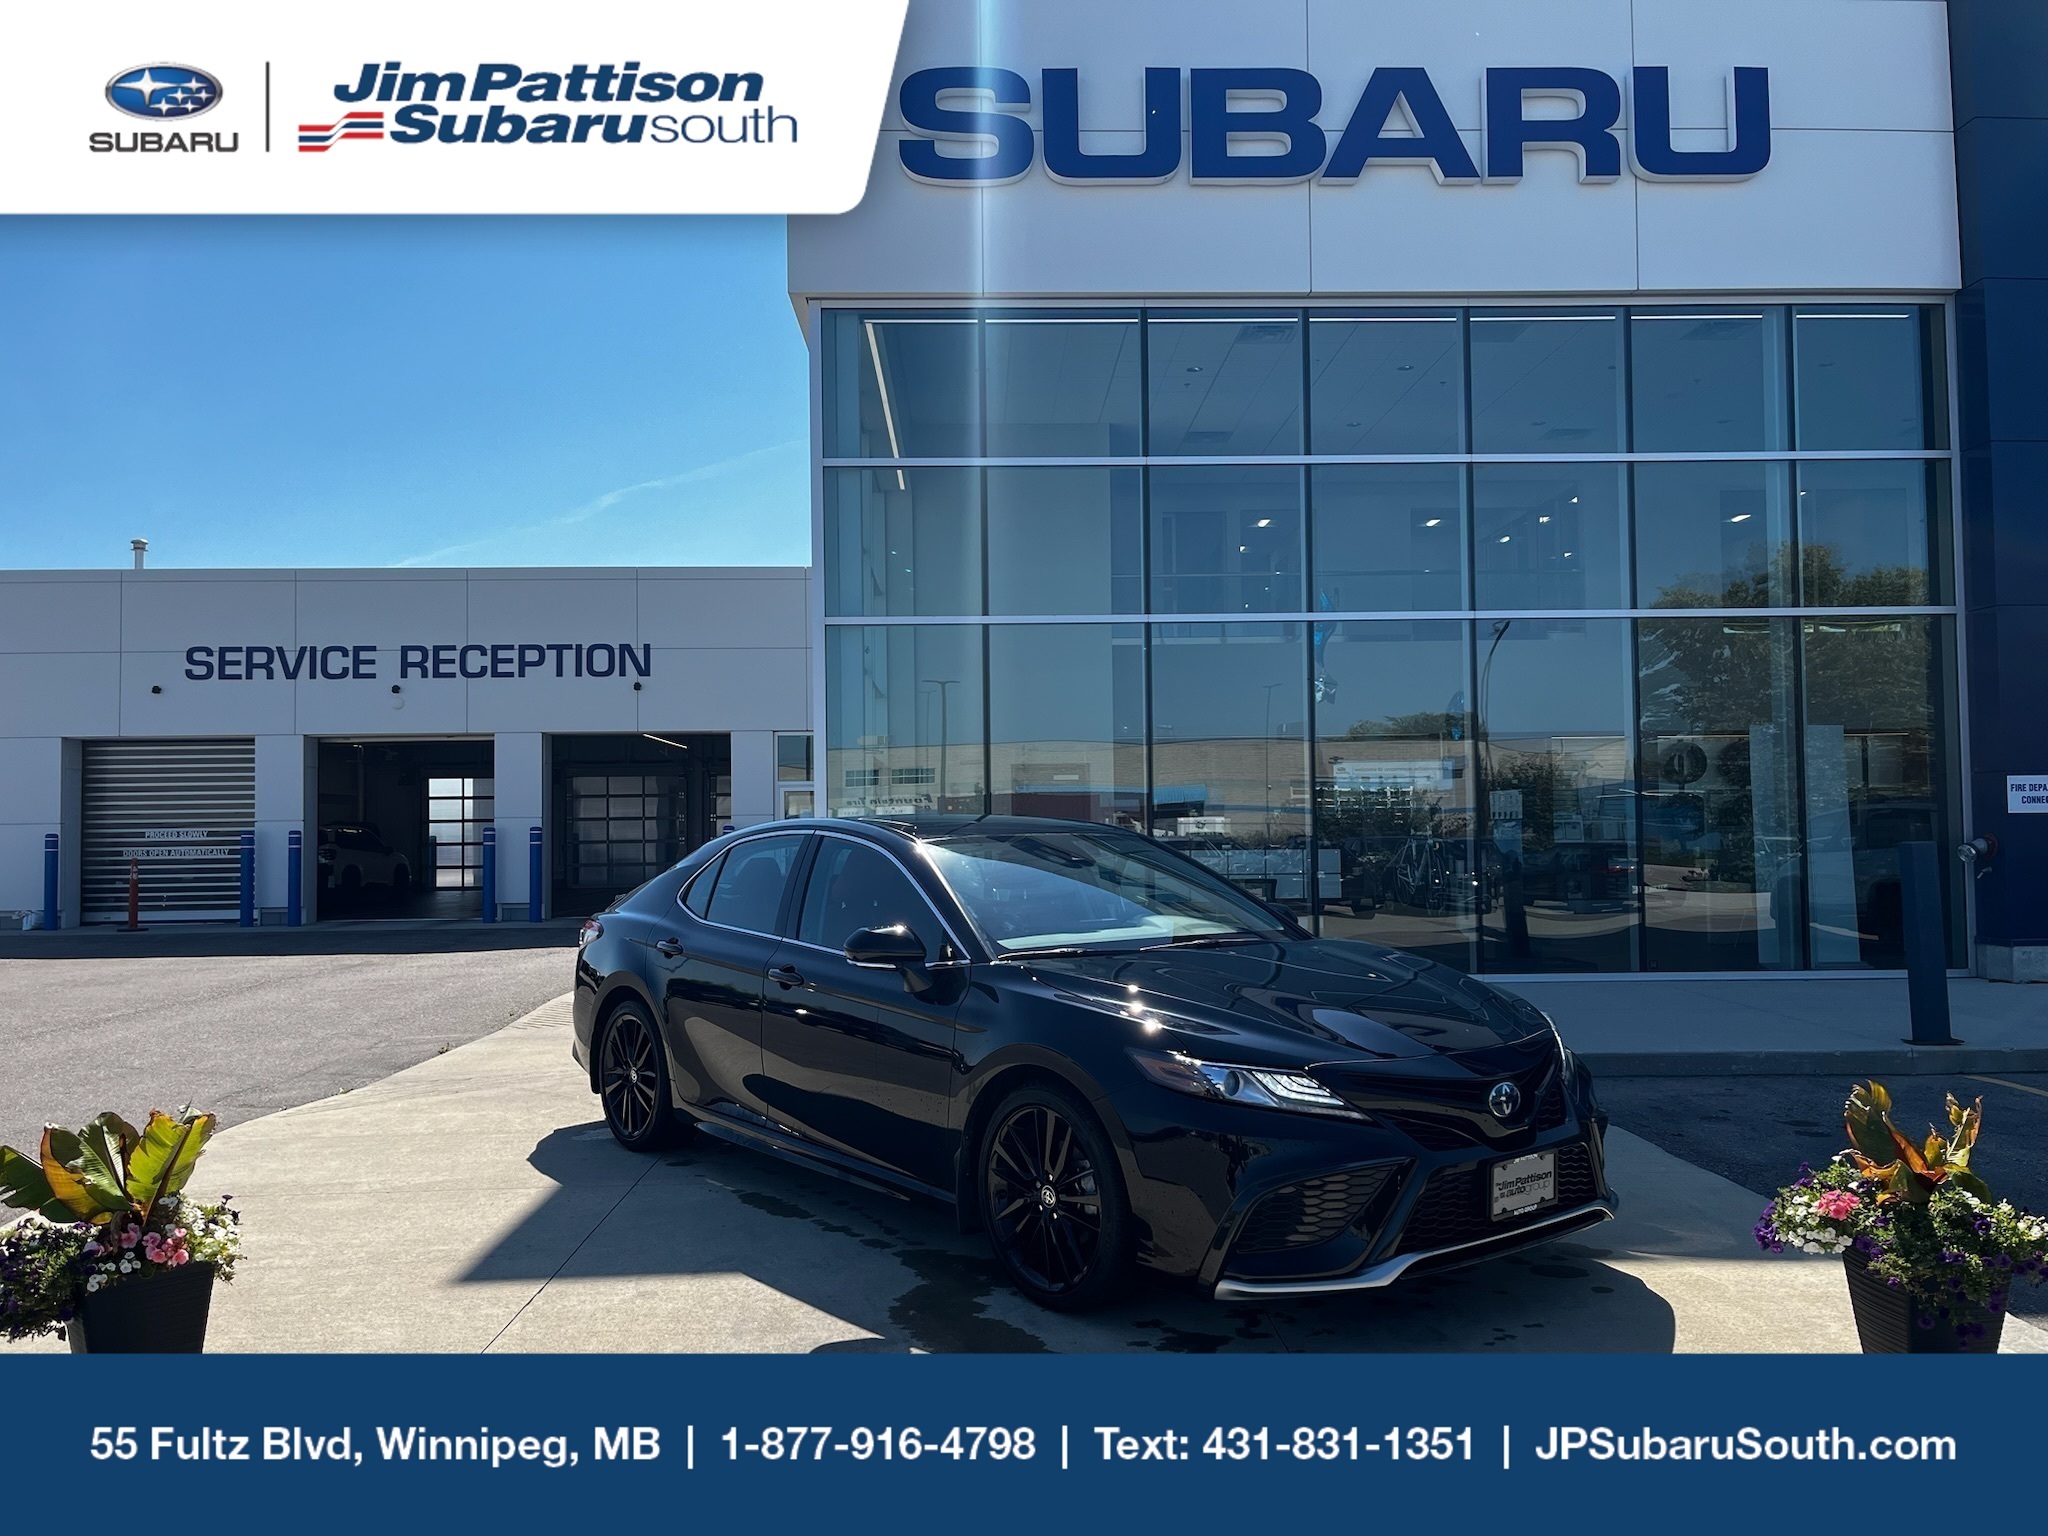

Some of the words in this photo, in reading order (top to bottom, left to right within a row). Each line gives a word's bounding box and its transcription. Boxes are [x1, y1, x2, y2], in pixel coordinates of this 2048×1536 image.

[899, 66, 1771, 186] SUBARU
[185, 646, 377, 681] SERVICE
[400, 643, 651, 679] RECEPTION
[2011, 784, 2026, 792] FIRE
[144, 831, 178, 839] PROCEED
[179, 830, 208, 838] SLOWLY
[122, 849, 148, 857] DOORS
[149, 849, 168, 857] OPEN
[170, 848, 229, 856] AUTOMATICALLY
